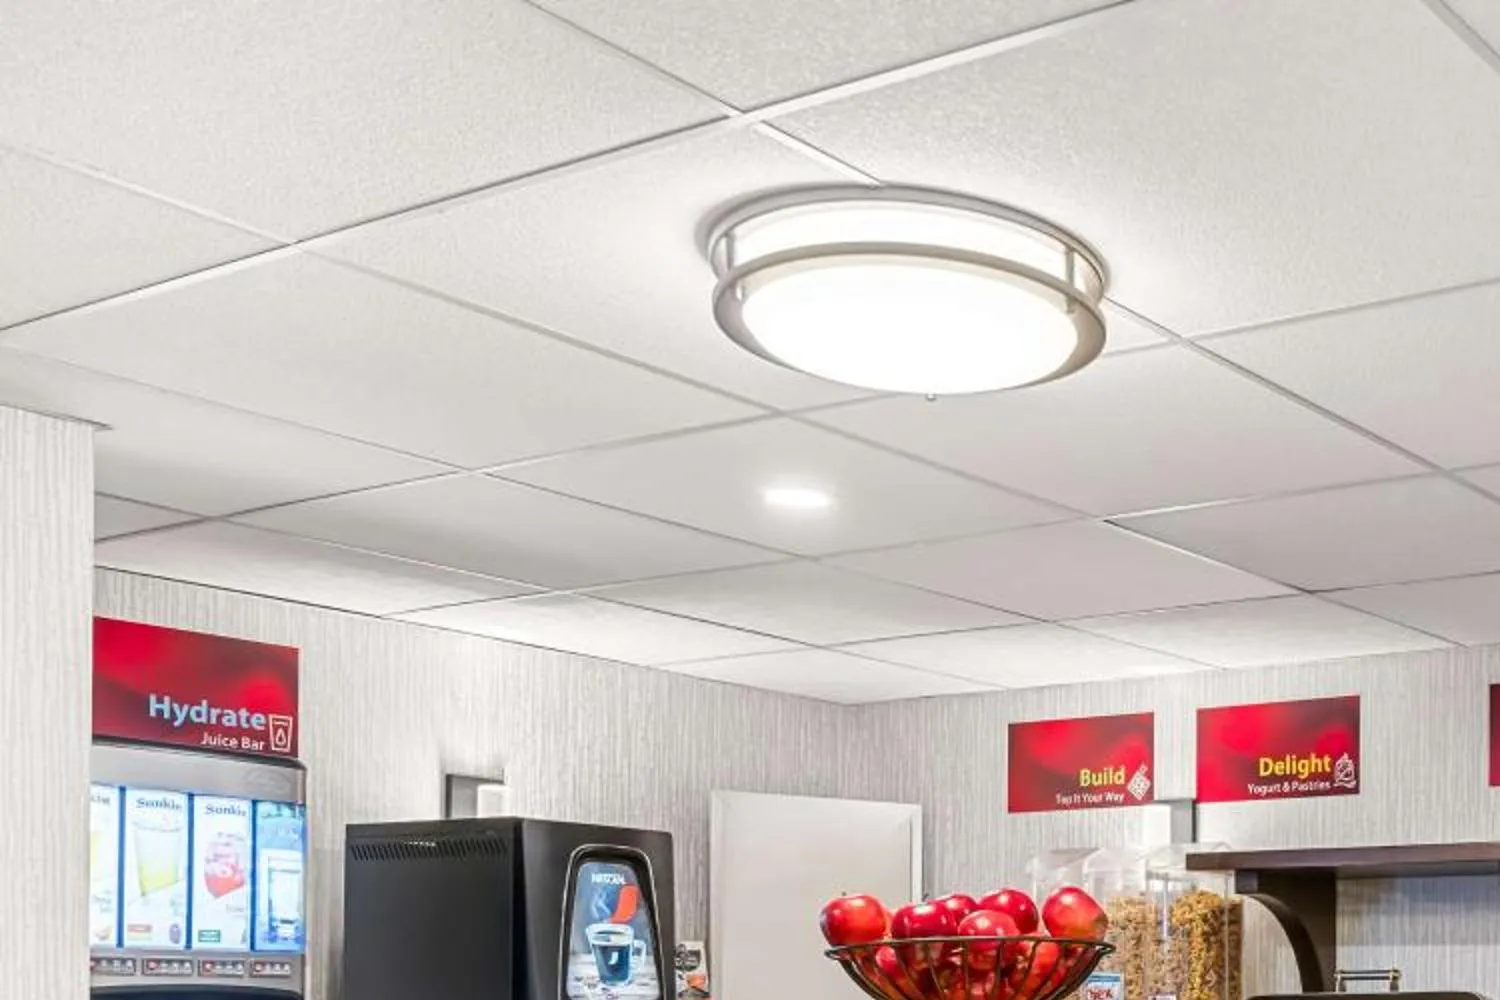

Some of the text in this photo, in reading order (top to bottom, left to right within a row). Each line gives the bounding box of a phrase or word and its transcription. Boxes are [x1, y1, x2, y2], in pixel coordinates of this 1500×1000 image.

[149, 693, 266, 731] Hydrate
[201, 732, 265, 751] Juice Bar
[1259, 752, 1332, 779] Delight
[1080, 766, 1125, 787] Build
[1082, 792, 1103, 803] Your
[1104, 791, 1125, 803] Way
[1247, 780, 1331, 797] Yogurt & Pastries
